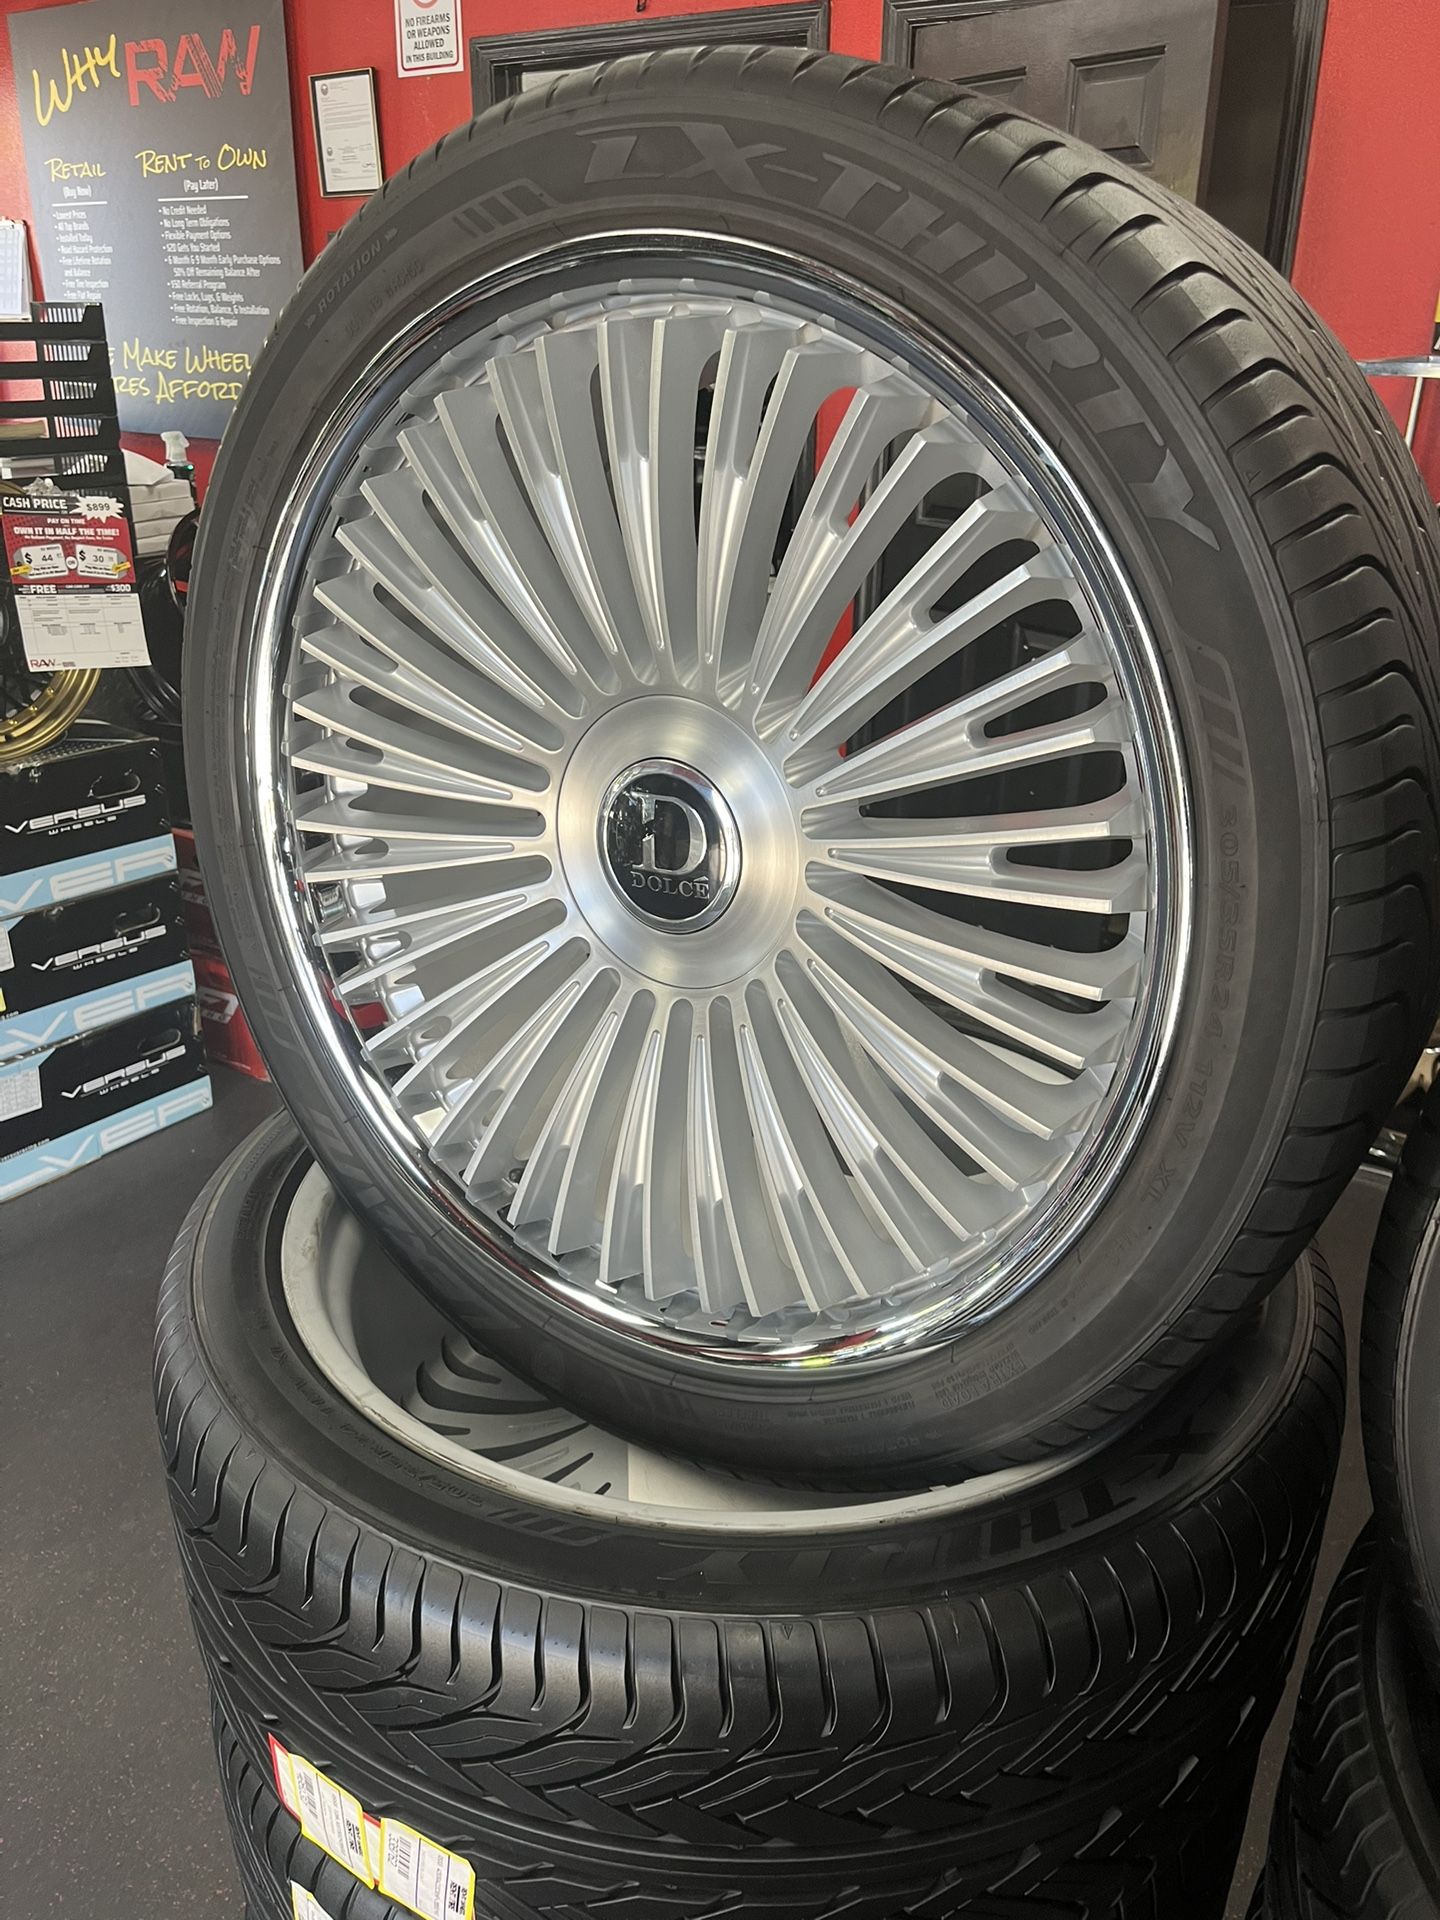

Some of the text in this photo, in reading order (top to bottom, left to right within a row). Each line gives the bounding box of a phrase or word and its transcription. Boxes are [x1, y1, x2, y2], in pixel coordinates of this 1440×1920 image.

[405, 13, 451, 27] NO FIREARMS
[406, 25, 450, 39] OR WEAPONS
[414, 38, 445, 50] ALLOWED
[405, 50, 454, 63] IN THIS BUILDING
[32, 25, 261, 126] WHY RAW
[44, 158, 107, 182] RETAIL
[135, 149, 193, 178] RENT
[217, 143, 268, 171] OWN
[184, 178, 219, 193] (Pay Later)
[162, 204, 207, 215] No Credit Needed
[163, 218, 171, 228] No
[171, 218, 185, 230] Long
[186, 230, 210, 242] Payment
[210, 230, 232, 241] Options
[317, 239, 383, 313] ROTATION
[575, 120, 1222, 553] LX-THIRTY
[123, 337, 178, 372] MAKE
[184, 344, 252, 374] WHEEL
[111, 374, 151, 396] RES
[2, 496, 111, 513] CASH PRICE $899
[13, 526, 120, 537] OWN IT IN HALF THE TIME!
[24, 552, 33, 565] $
[41, 554, 54, 562] 44
[78, 550, 86, 562] $
[92, 554, 105, 563] 30
[31, 584, 57, 594] FREE
[111, 584, 132, 592] $300
[30, 659, 56, 668] RAW
[4, 794, 147, 834] VERSUS
[48, 815, 117, 836] WHEELS
[31, 924, 168, 972] VERSUS
[72, 945, 139, 971] WHEELS
[61, 1044, 187, 1100] VERSUS
[99, 1067, 161, 1097] WHEELS
